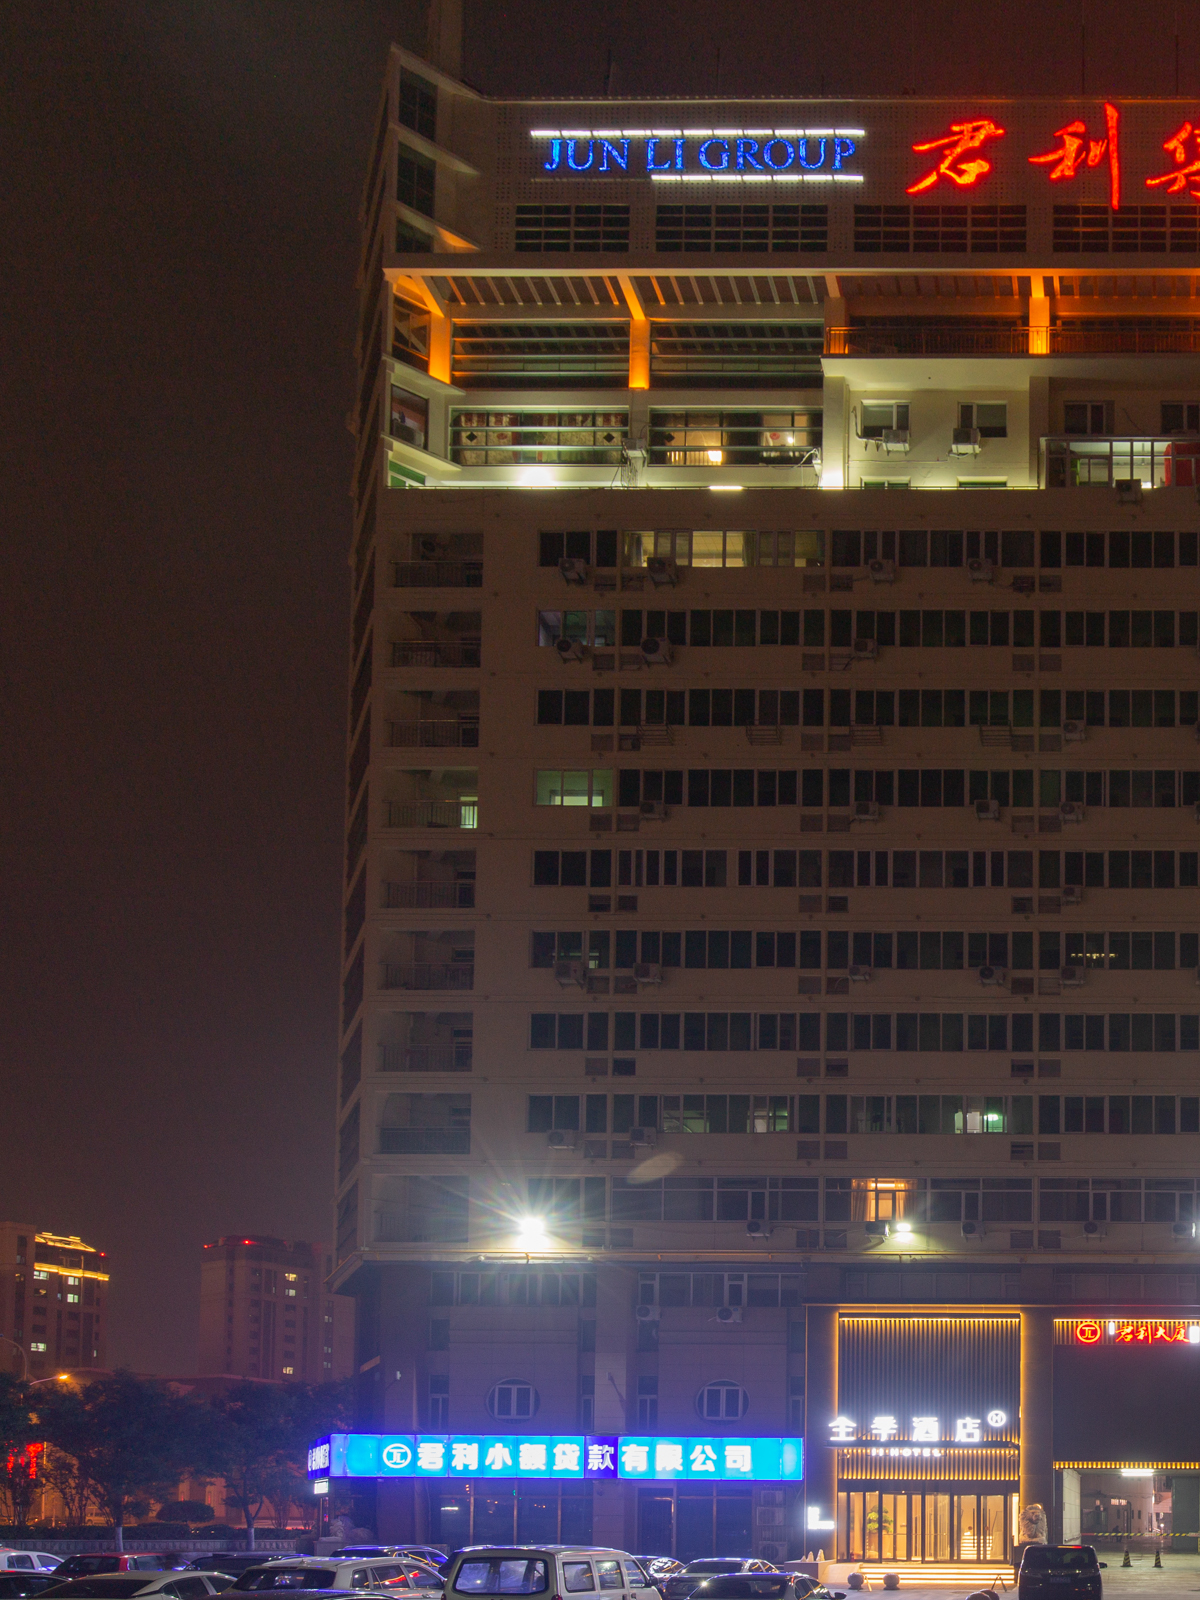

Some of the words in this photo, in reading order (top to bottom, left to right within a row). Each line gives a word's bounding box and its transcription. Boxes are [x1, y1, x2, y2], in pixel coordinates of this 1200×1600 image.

[544, 138, 630, 172] JUN
[645, 138, 686, 171] LI
[699, 136, 856, 170] GROUP
[1115, 1324, 1190, 1344] 君利大厦
[828, 1415, 981, 1442] 全季酒店
[416, 1440, 754, 1472] 君利小额贷款有限公司
